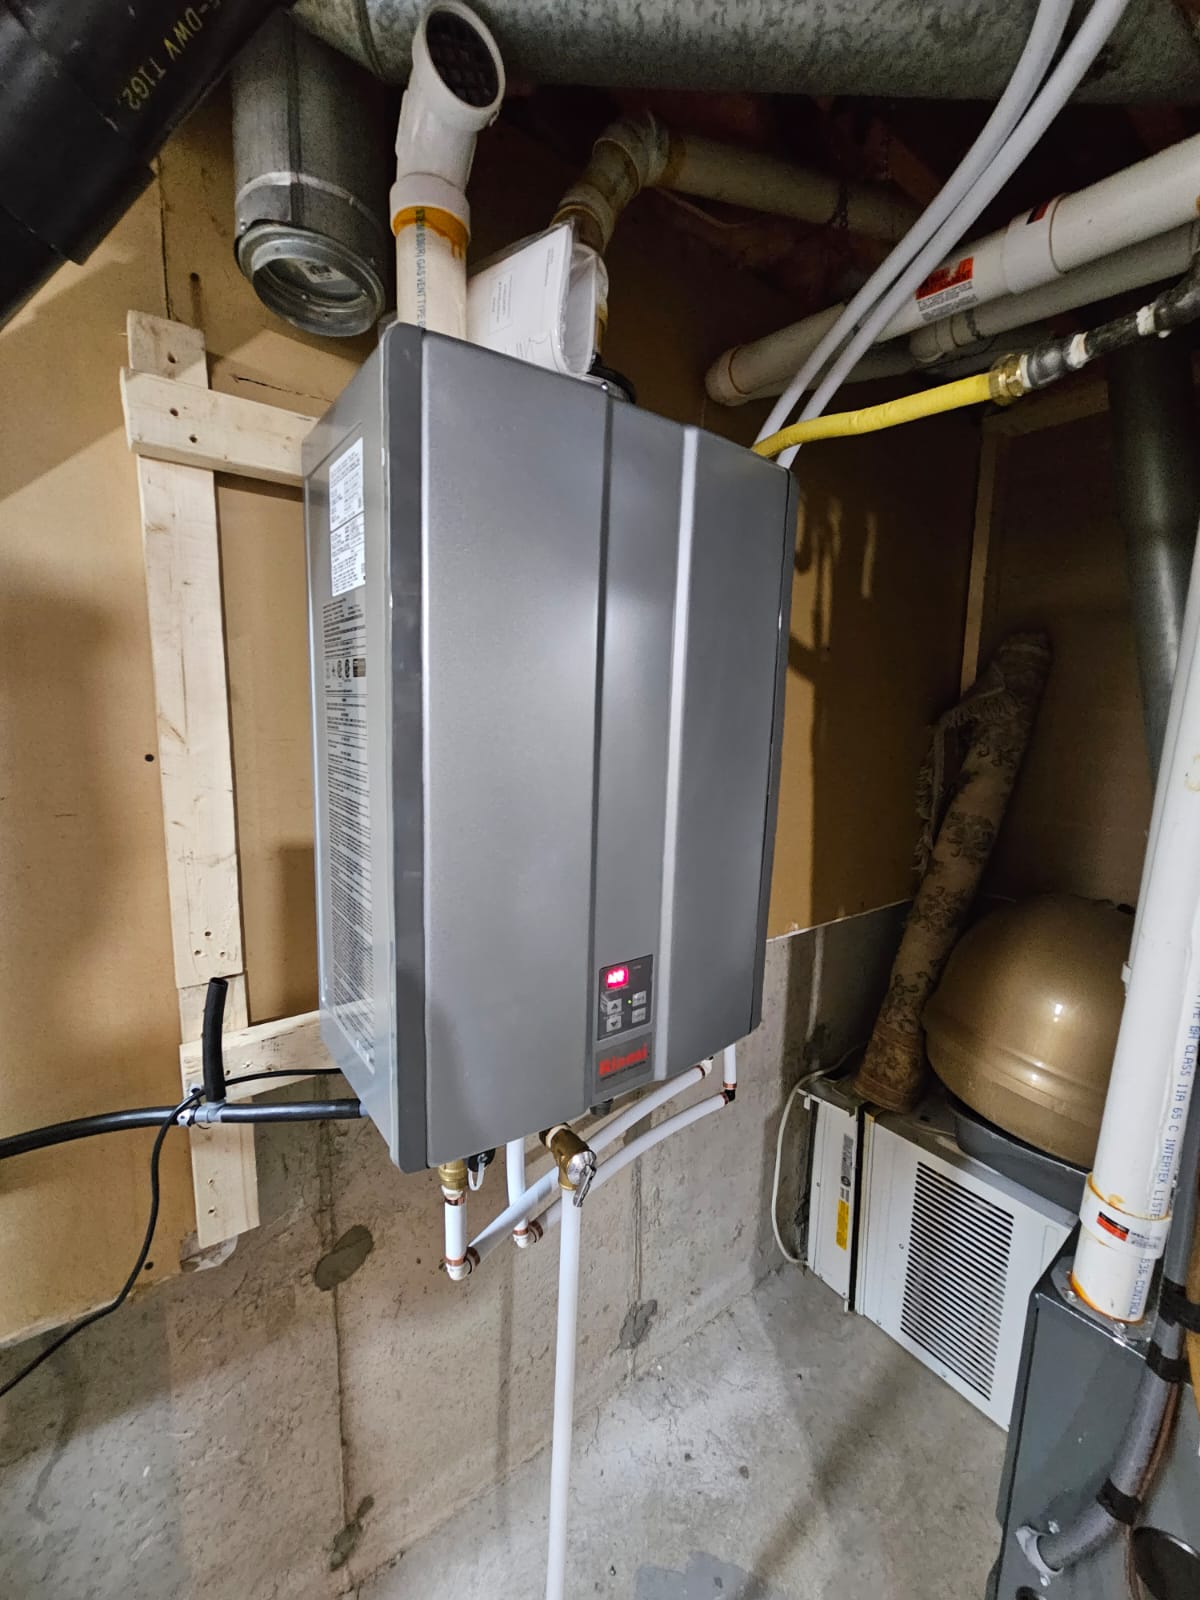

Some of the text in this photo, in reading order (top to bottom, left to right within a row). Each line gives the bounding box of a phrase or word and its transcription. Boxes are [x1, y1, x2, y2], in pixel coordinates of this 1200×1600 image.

[415, 259, 426, 277] GAS
[416, 277, 426, 297] VENT
[1179, 1043, 1198, 1078] CLASS
[1170, 1106, 1184, 1120] 65
[1167, 1124, 1180, 1133] C
[1157, 1138, 1177, 1185] INTERTEK
[1127, 1279, 1147, 1318] CONTROL
